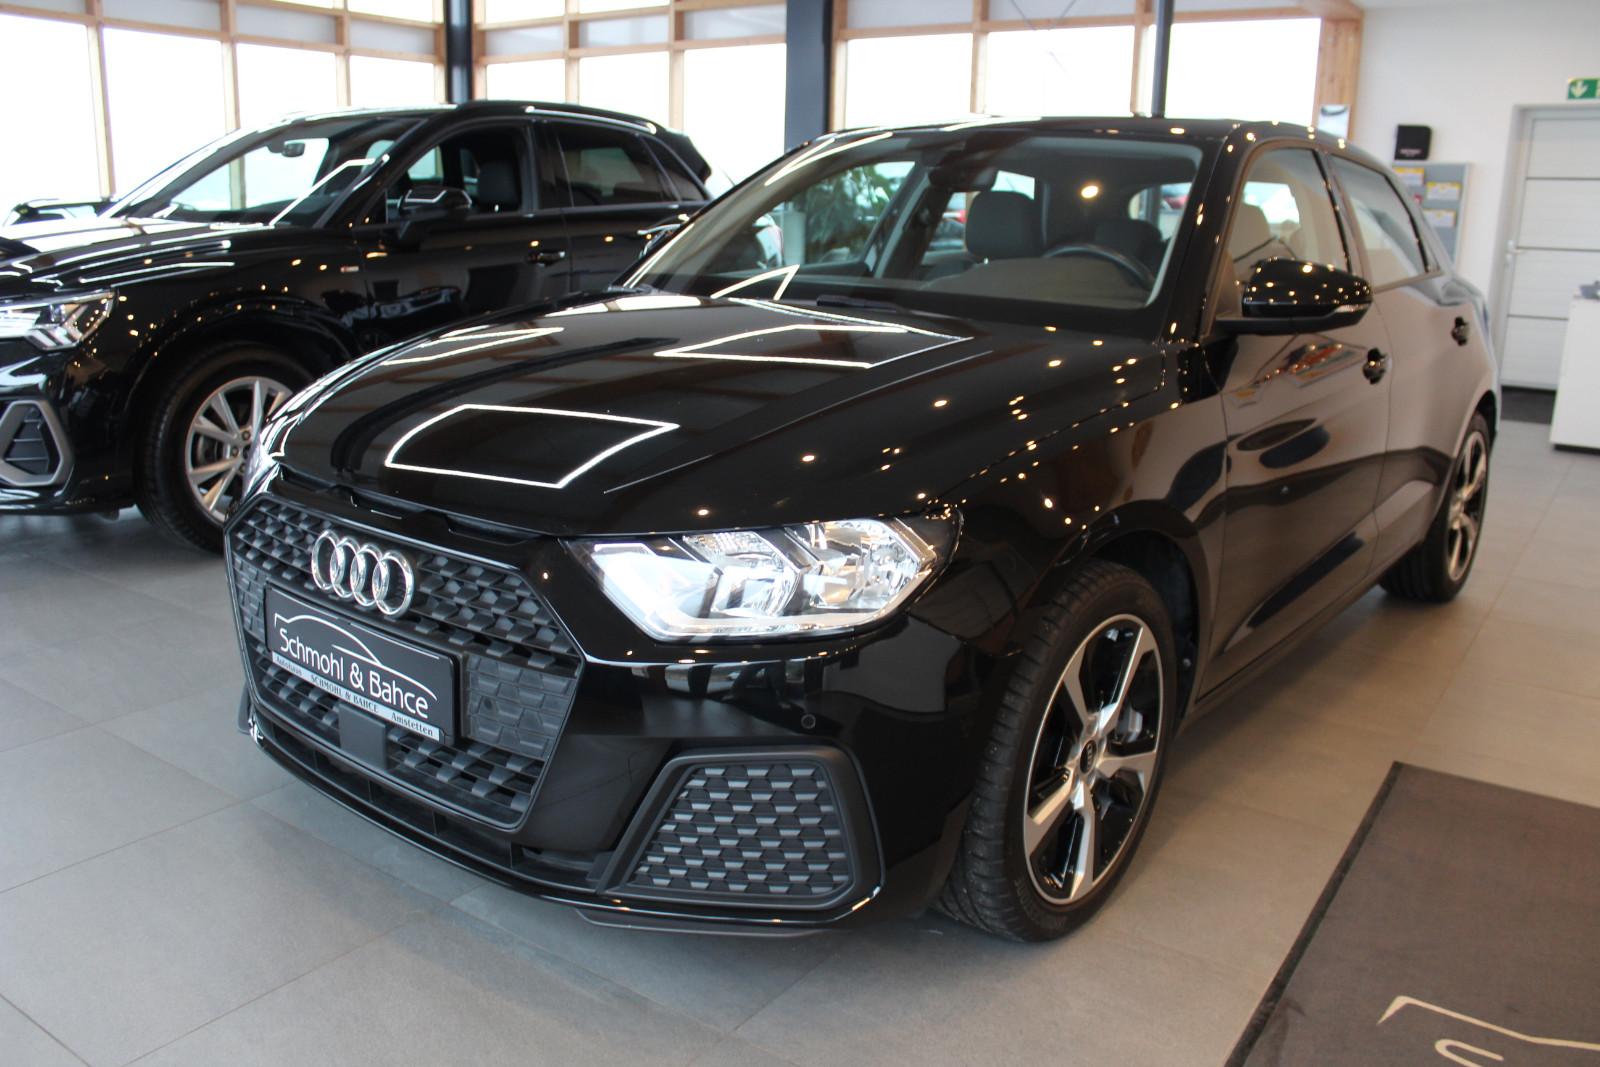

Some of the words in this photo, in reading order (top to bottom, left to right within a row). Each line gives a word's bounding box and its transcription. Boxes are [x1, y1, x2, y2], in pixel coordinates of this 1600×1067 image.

[279, 627, 344, 682] Schmohl
[349, 662, 365, 692] &
[369, 670, 429, 719] Bahce
[310, 674, 342, 697] SCHMOHL
[344, 690, 352, 701] &
[353, 695, 379, 713] BAHCE
[391, 711, 434, 737] Amstetten
